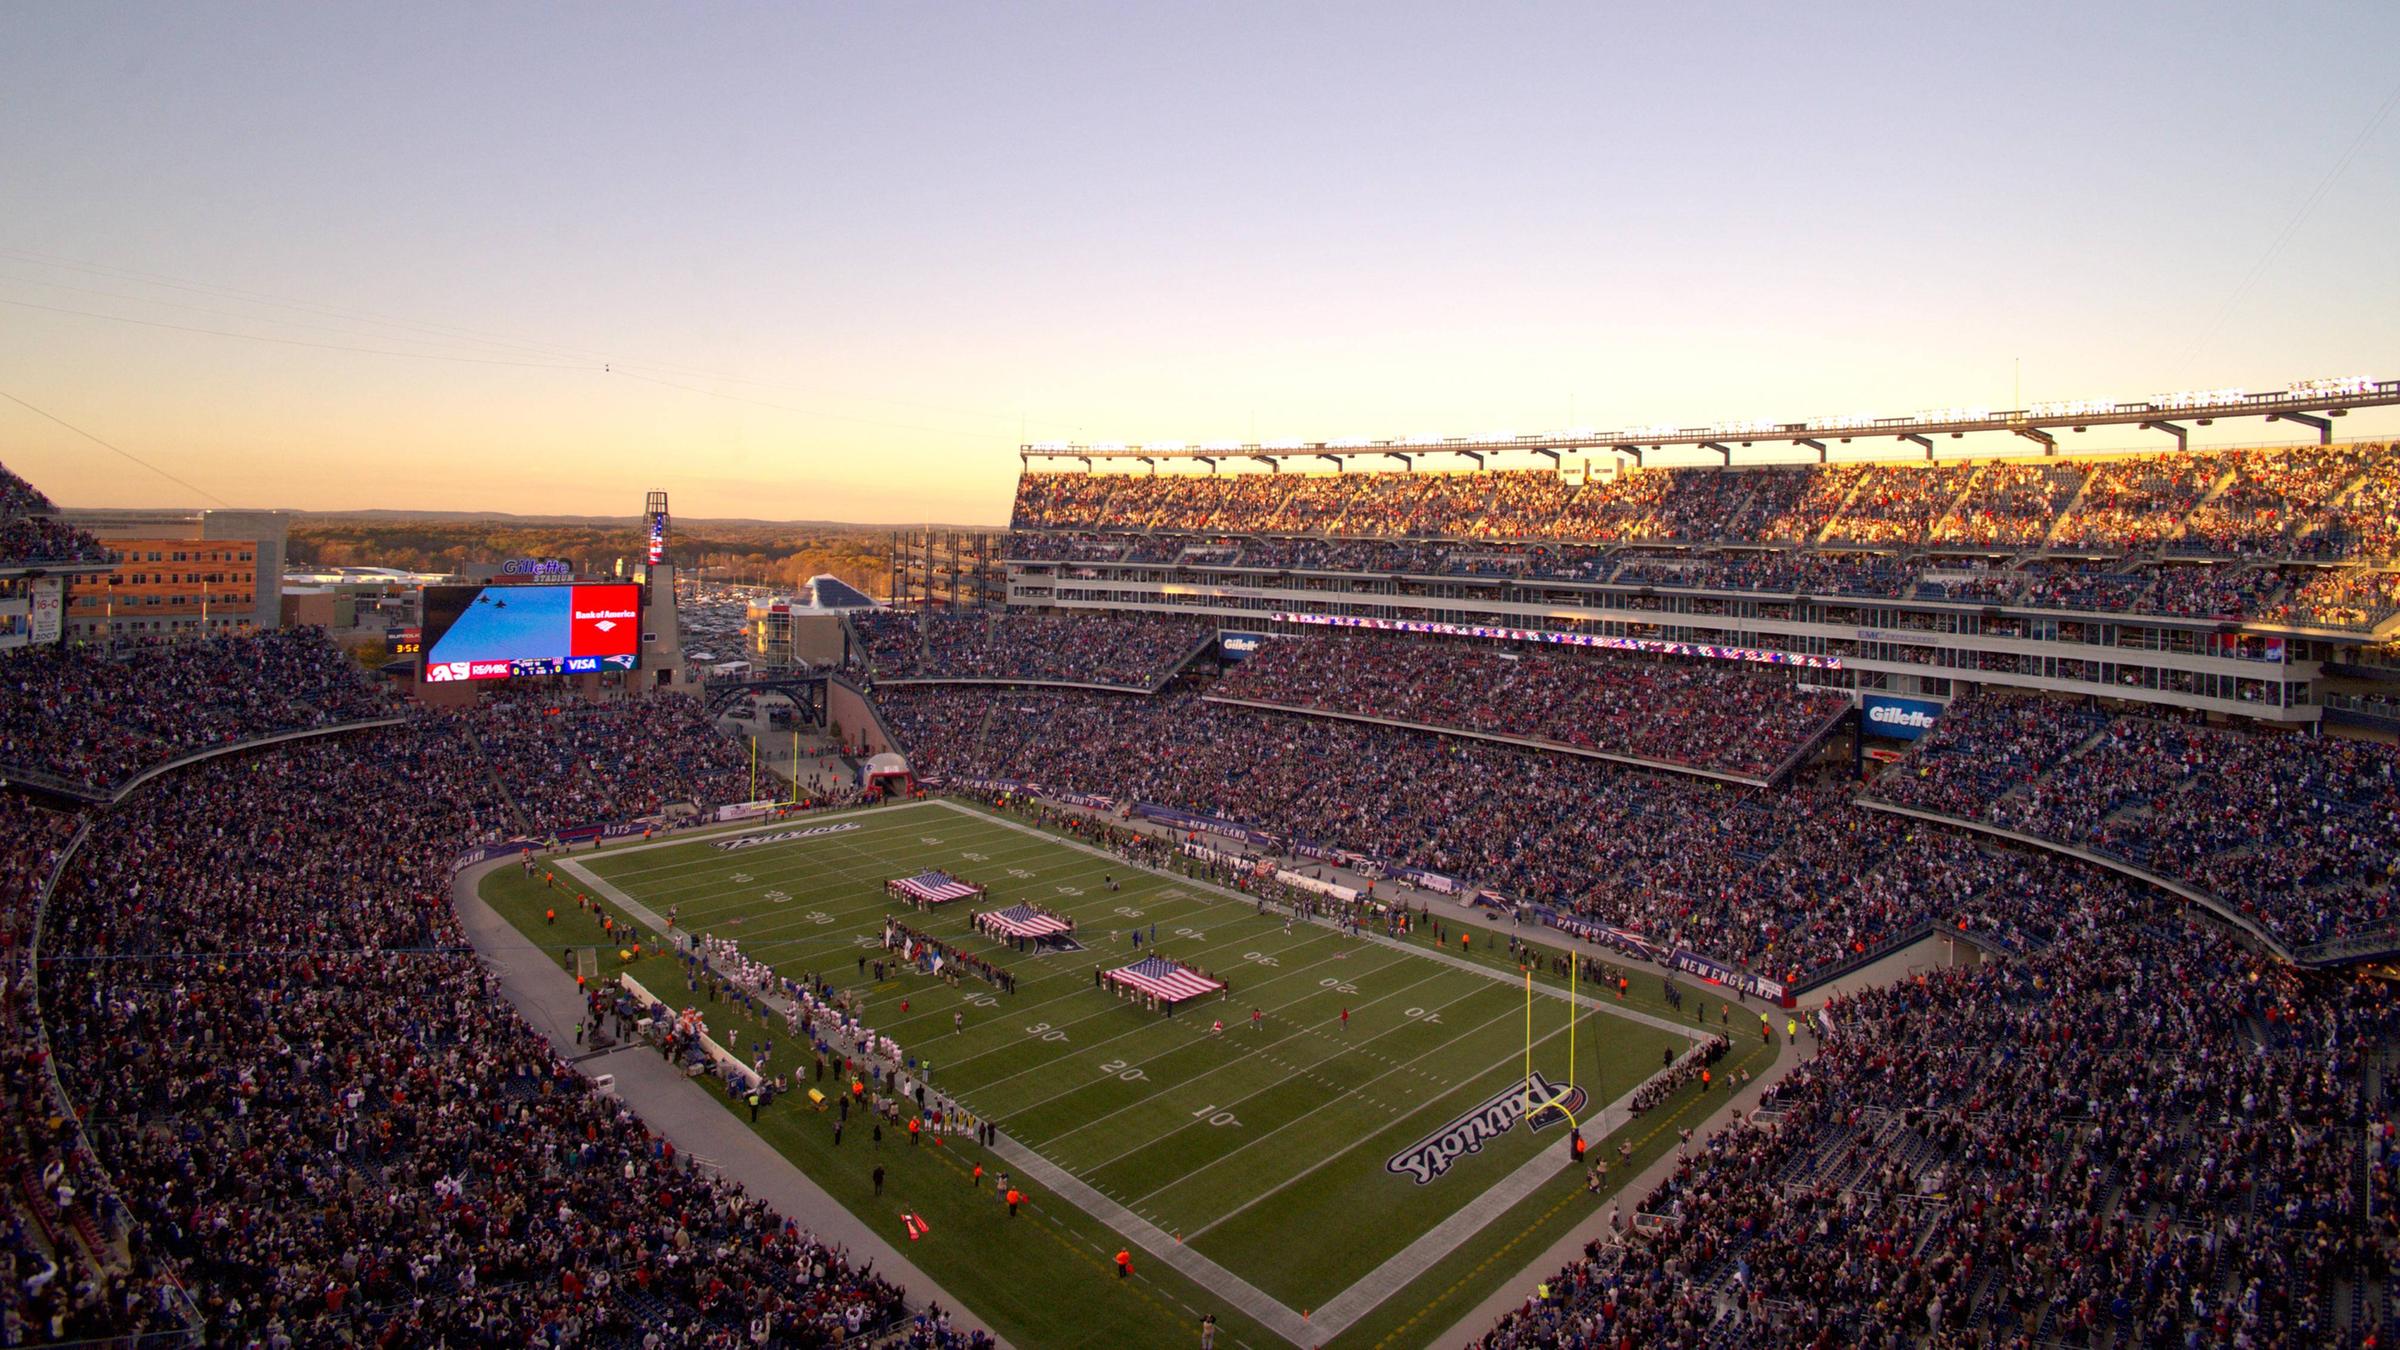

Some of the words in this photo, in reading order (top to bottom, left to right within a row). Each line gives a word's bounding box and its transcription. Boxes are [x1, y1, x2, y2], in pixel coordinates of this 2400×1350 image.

[503, 559, 570, 575] Gillette
[533, 574, 575, 583] STADIUM
[575, 611, 595, 620] Bank
[595, 610, 605, 619] of
[604, 609, 636, 618] America
[472, 663, 509, 676] RE/MAX
[567, 658, 597, 671] VISA
[1869, 706, 1935, 729] Gillette
[1679, 957, 1710, 978] NEW
[1025, 1022, 1066, 1042] 30
[1099, 1059, 1145, 1081] 20
[1191, 1104, 1236, 1127] 10
[1386, 1070, 1588, 1184] Patriots
